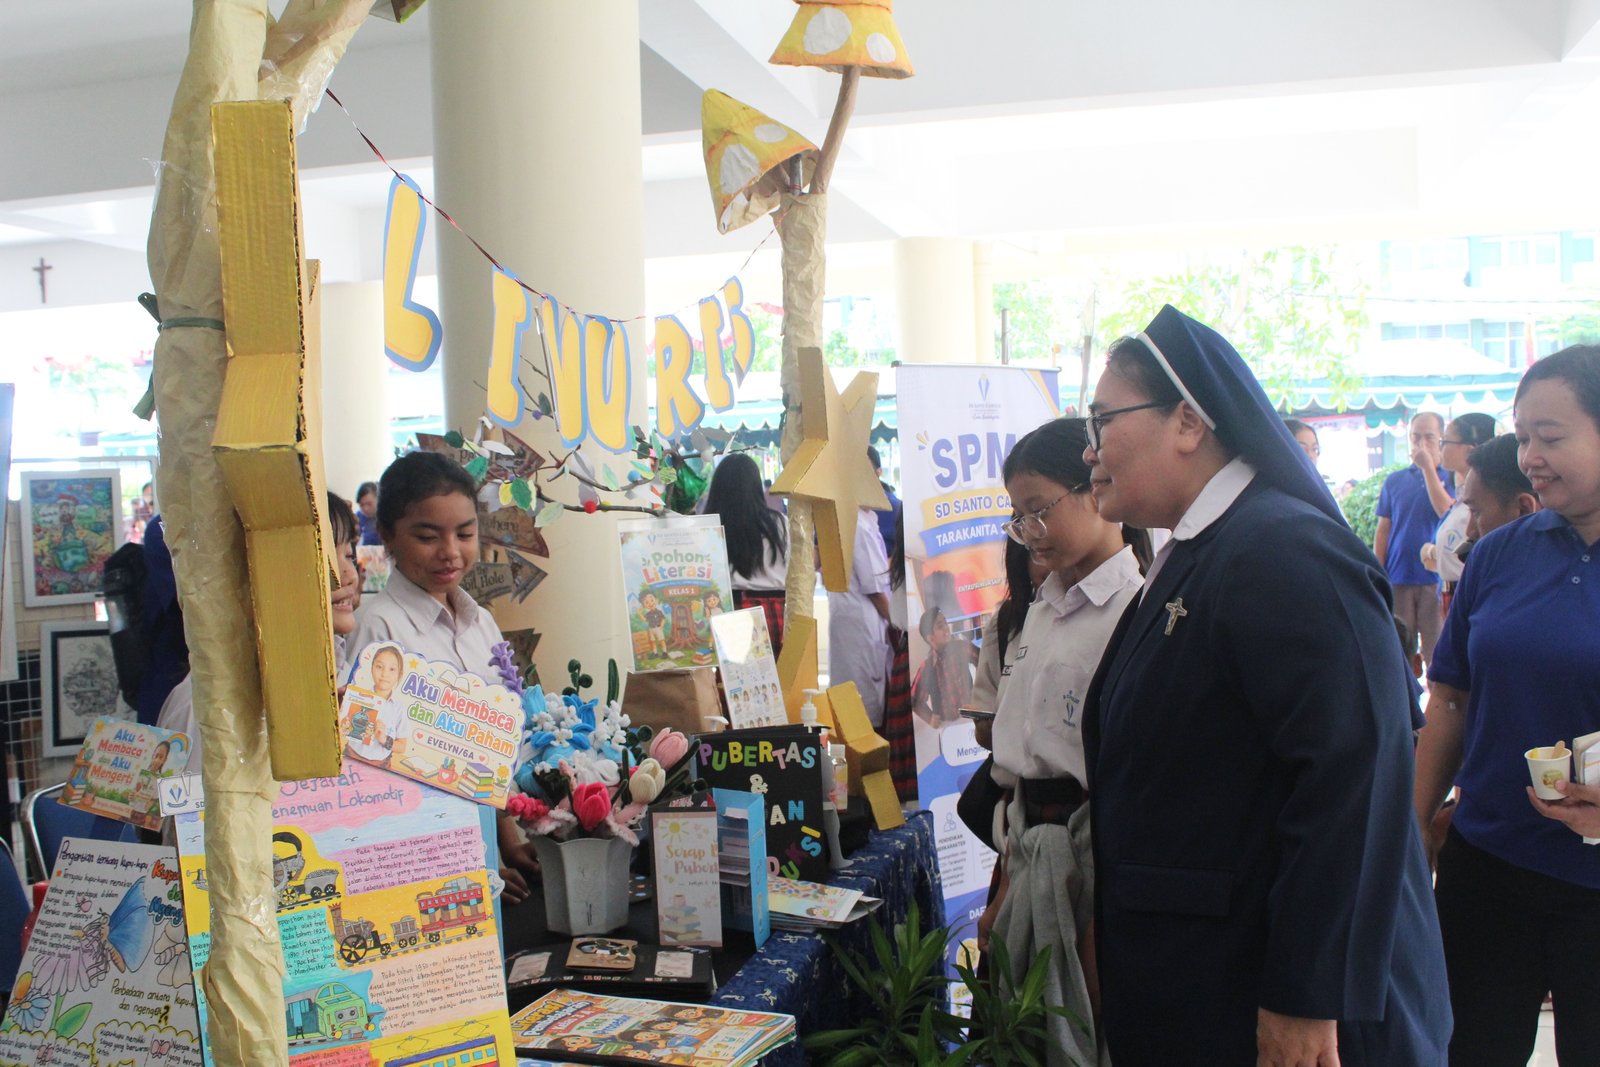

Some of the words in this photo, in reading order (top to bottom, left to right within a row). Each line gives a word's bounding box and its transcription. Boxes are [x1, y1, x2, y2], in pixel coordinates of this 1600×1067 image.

[931, 431, 1016, 489] SPM
[935, 501, 951, 518] SD
[954, 495, 992, 515] SANTO
[936, 523, 998, 547] TARAKANITA
[652, 549, 705, 566] Pohon
[481, 571, 505, 588] Hole
[643, 564, 713, 584] Literasi
[669, 587, 690, 596] KELAS
[402, 672, 440, 703] Aku
[440, 687, 516, 734] Membaca
[114, 729, 136, 743] Aku
[407, 702, 435, 726] dan
[434, 712, 466, 738] Aku
[465, 722, 515, 758] Paham
[98, 739, 143, 757] Membaca
[427, 736, 474, 760] EVELYN/6A
[700, 741, 816, 771] PUBERTAS
[110, 757, 131, 770] Aku
[90, 766, 134, 785] Mengerti
[749, 773, 768, 794] &
[271, 801, 333, 819] enemuan
[338, 784, 405, 808] Lokomotif
[666, 844, 706, 861] Scrap
[167, 883, 181, 901] da
[149, 896, 183, 925] Ngeng
[111, 978, 144, 999] Perbedaan
[119, 997, 130, 1010] dan
